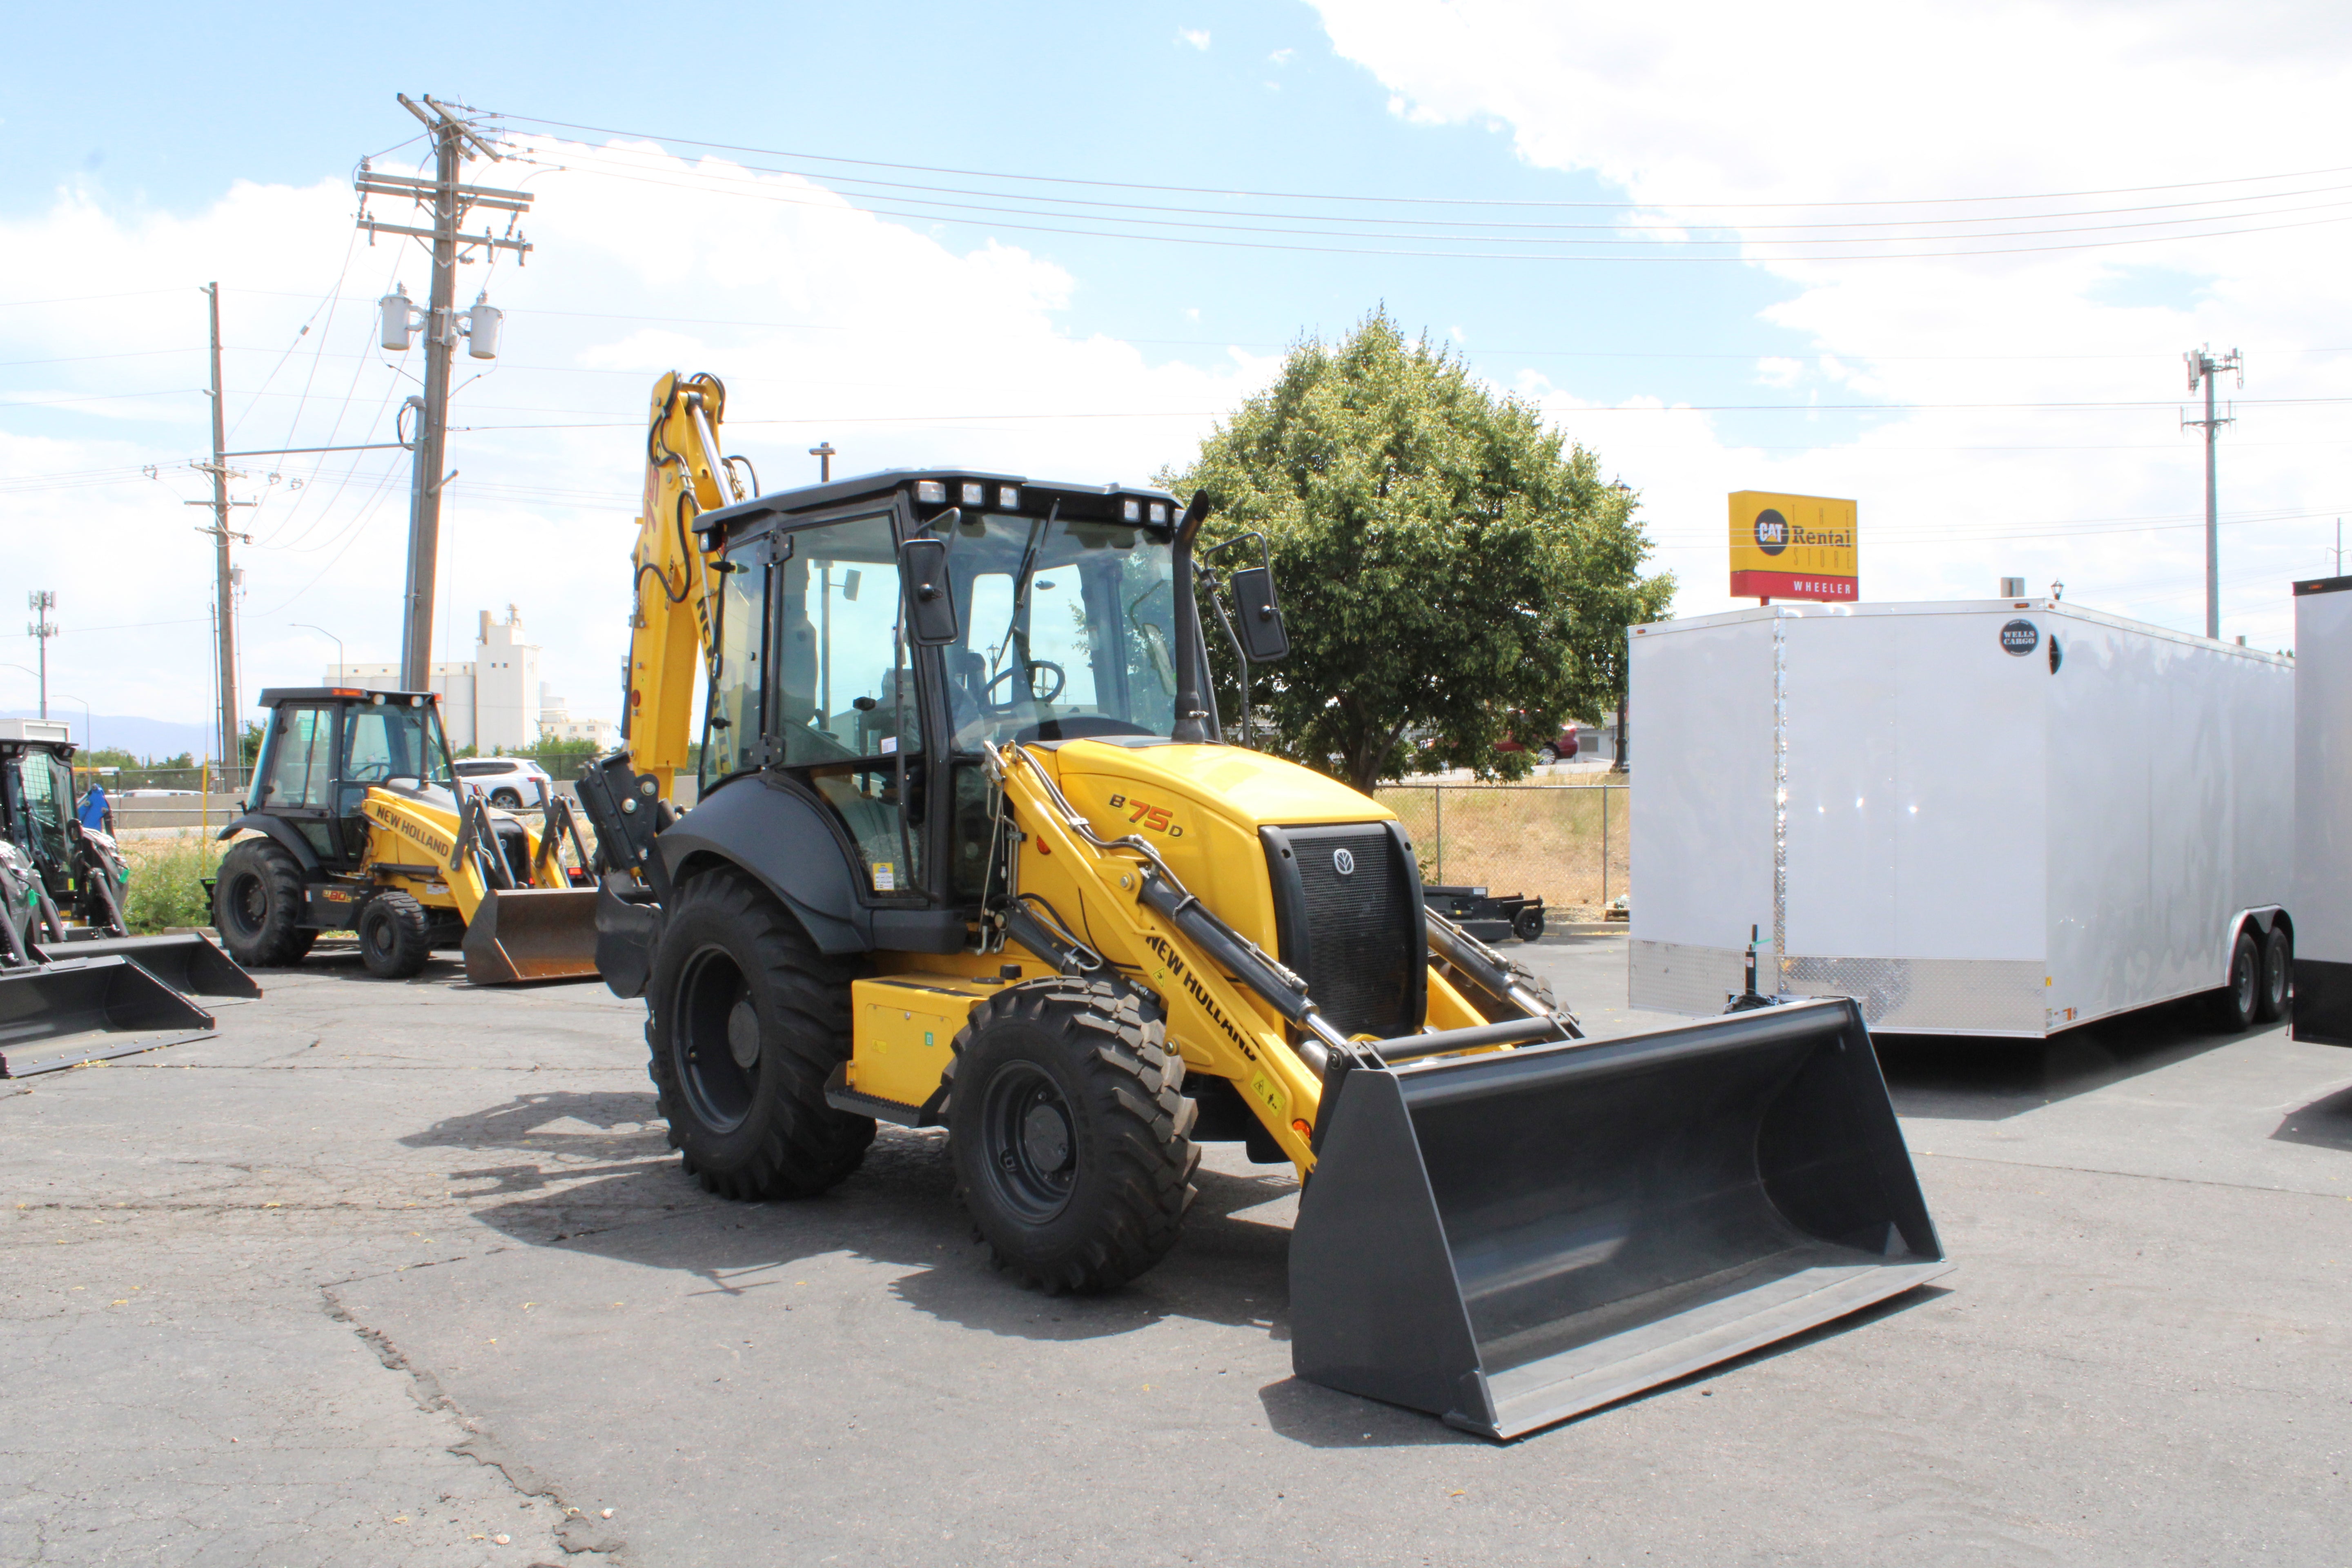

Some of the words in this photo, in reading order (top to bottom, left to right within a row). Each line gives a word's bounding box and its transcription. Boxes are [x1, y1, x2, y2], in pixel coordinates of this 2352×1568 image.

[1792, 504, 1849, 527] THE
[1759, 522, 1783, 543] CAT
[1792, 525, 1851, 548] Rental
[1793, 548, 1851, 569] STORE
[1793, 581, 1851, 594] WHEELER
[376, 805, 401, 828] NEW
[401, 819, 449, 857] HOLLAND
[1145, 926, 1185, 976] NEW
[1183, 970, 1261, 1061] HOLLAND
